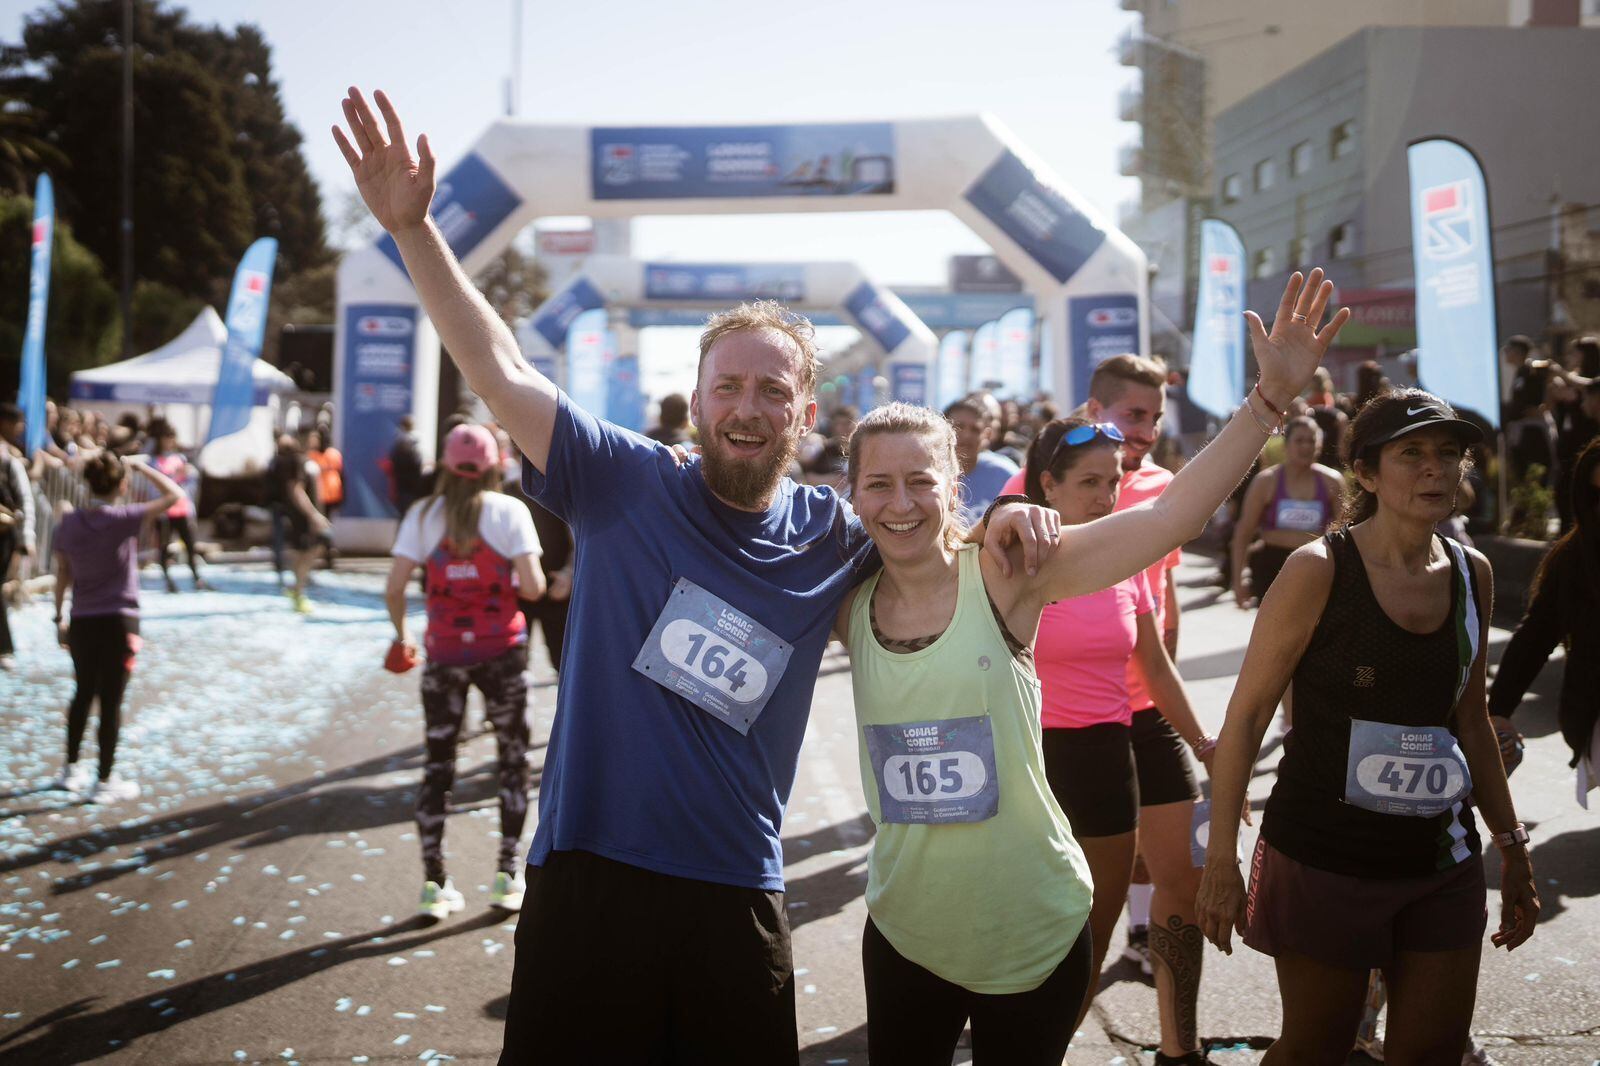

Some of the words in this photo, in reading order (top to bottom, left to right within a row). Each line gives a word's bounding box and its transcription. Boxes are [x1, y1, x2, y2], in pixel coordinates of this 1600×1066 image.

[717, 618, 749, 642] CORRE
[721, 608, 754, 633] LOMAS
[684, 633, 748, 693] 164
[903, 726, 938, 738] LOMAS
[906, 736, 939, 747] CORRE
[1401, 733, 1433, 742] LOMAS
[1401, 741, 1433, 751] CORRE
[898, 758, 963, 795] 165
[1377, 761, 1448, 795] 470
